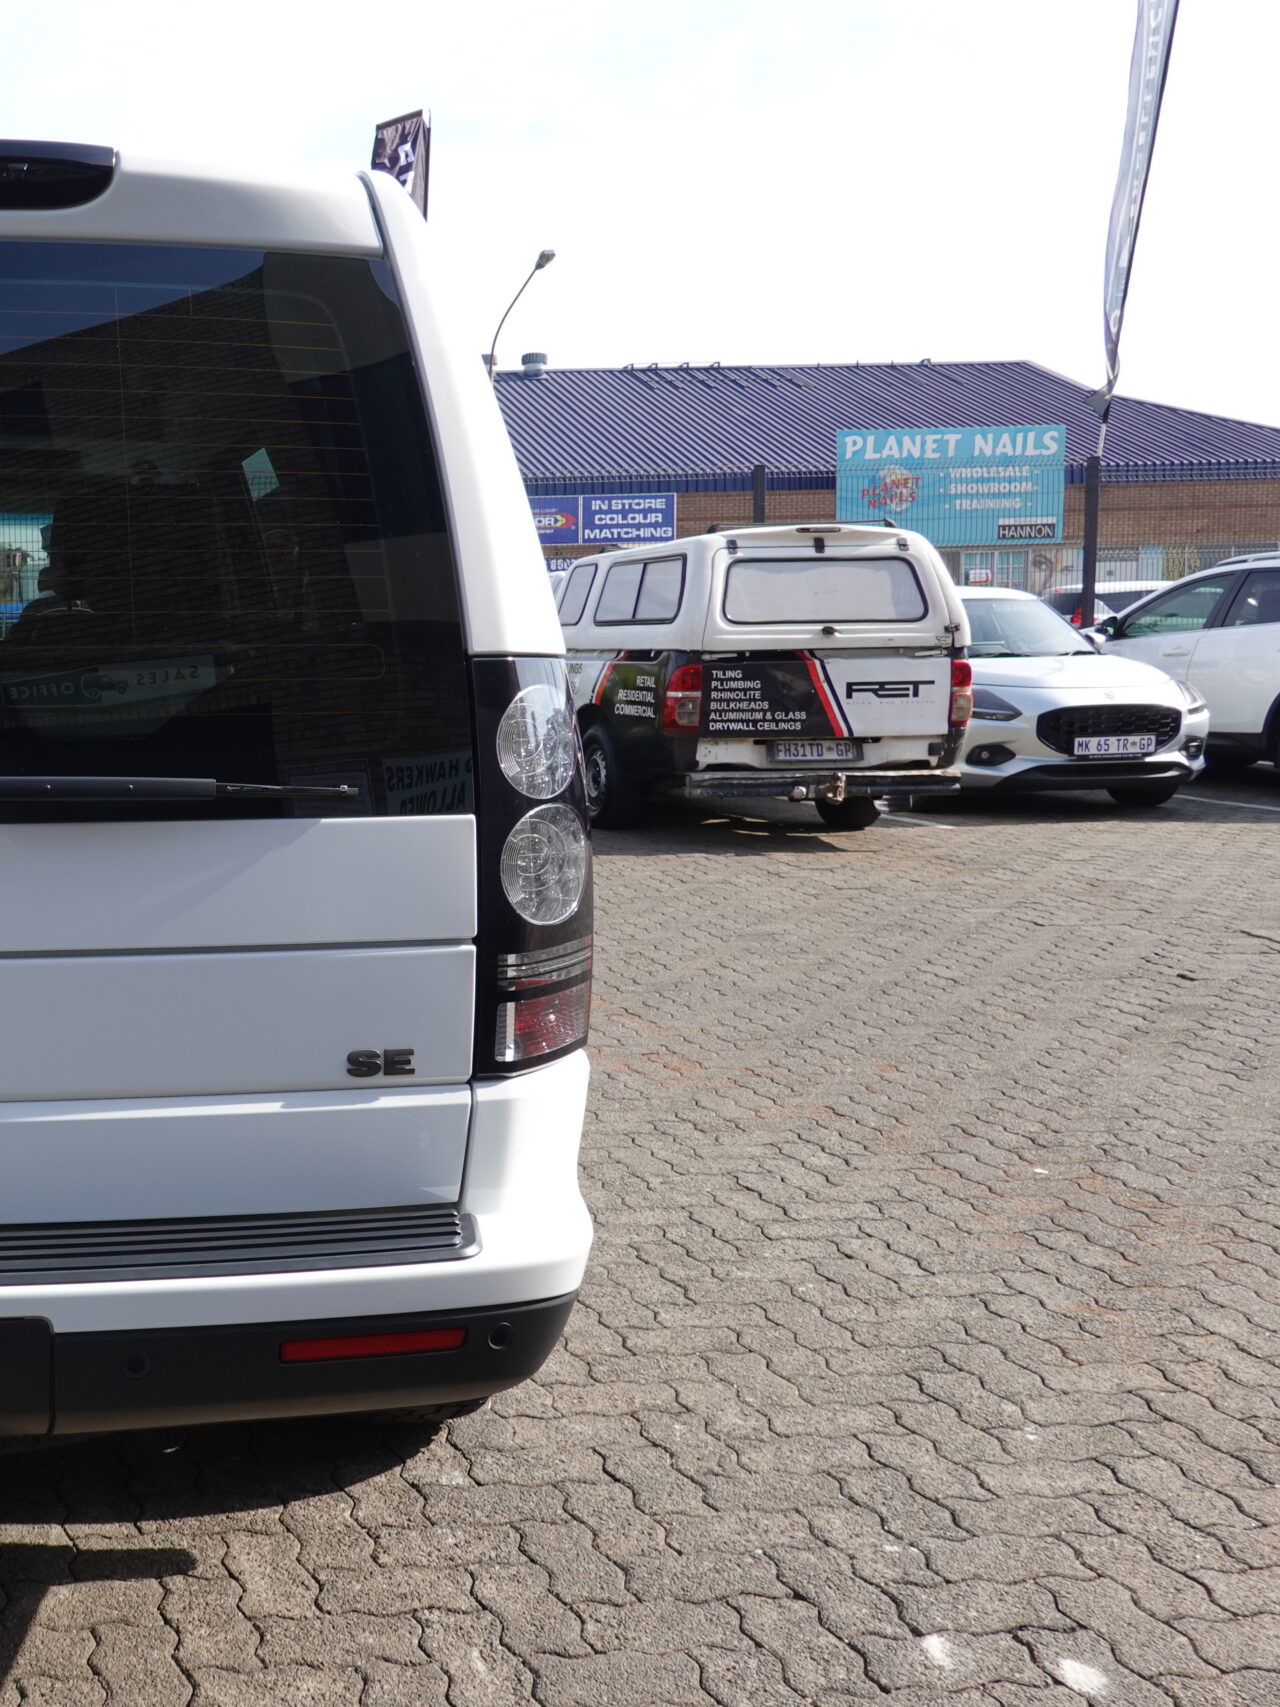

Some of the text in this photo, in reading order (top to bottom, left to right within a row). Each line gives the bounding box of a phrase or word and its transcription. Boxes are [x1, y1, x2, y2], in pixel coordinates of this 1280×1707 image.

[844, 430, 1059, 460] PLANET NAILS
[949, 465, 1031, 479] WHOLESALE
[861, 476, 922, 499] PLANET
[949, 482, 1032, 494] SHOWROOM
[591, 498, 666, 510] IN STORE
[867, 490, 918, 509] NAILS
[954, 498, 1022, 510] TRAINING
[594, 513, 663, 525] COLOUR
[584, 527, 673, 539] MATCHING
[999, 524, 1053, 539] HANNON
[712, 670, 742, 679] TILING
[636, 675, 656, 688] RETAIL
[711, 680, 761, 689] PLUMBING
[618, 690, 655, 703] RESIDENTIAL
[711, 691, 761, 699] RHINOLITE
[614, 703, 656, 719] COMMERCIAL
[710, 701, 769, 710] BULKHEADS
[709, 711, 806, 720] ALUMINIUM & GLASS
[709, 721, 801, 731] DRYWALL CEILINGS
[836, 743, 851, 757] GP
[1077, 737, 1153, 753] MK 65 TR GP
[346, 1048, 416, 1078] SE
